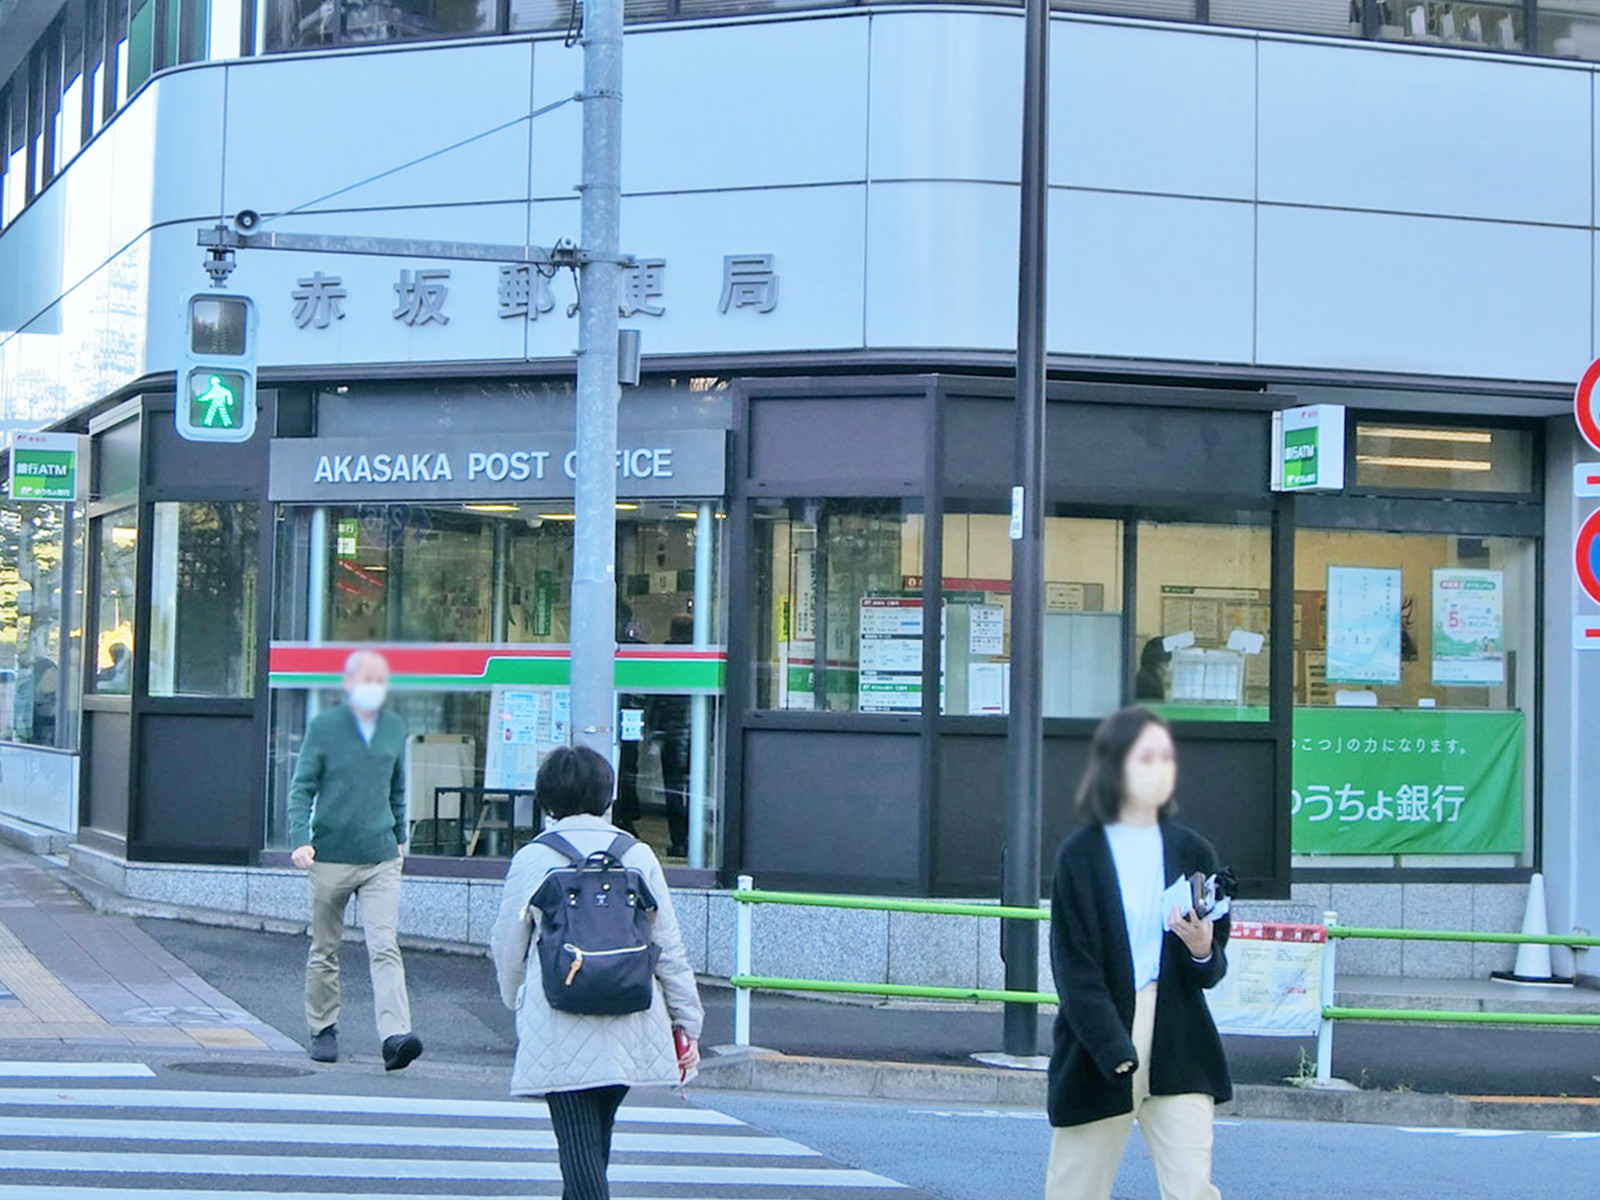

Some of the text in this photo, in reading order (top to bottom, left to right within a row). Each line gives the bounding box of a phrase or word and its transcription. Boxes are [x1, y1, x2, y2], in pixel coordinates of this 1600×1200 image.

[291, 253, 779, 329] 赤坂郵便局
[313, 448, 673, 483] AKASAKA POST OICE
